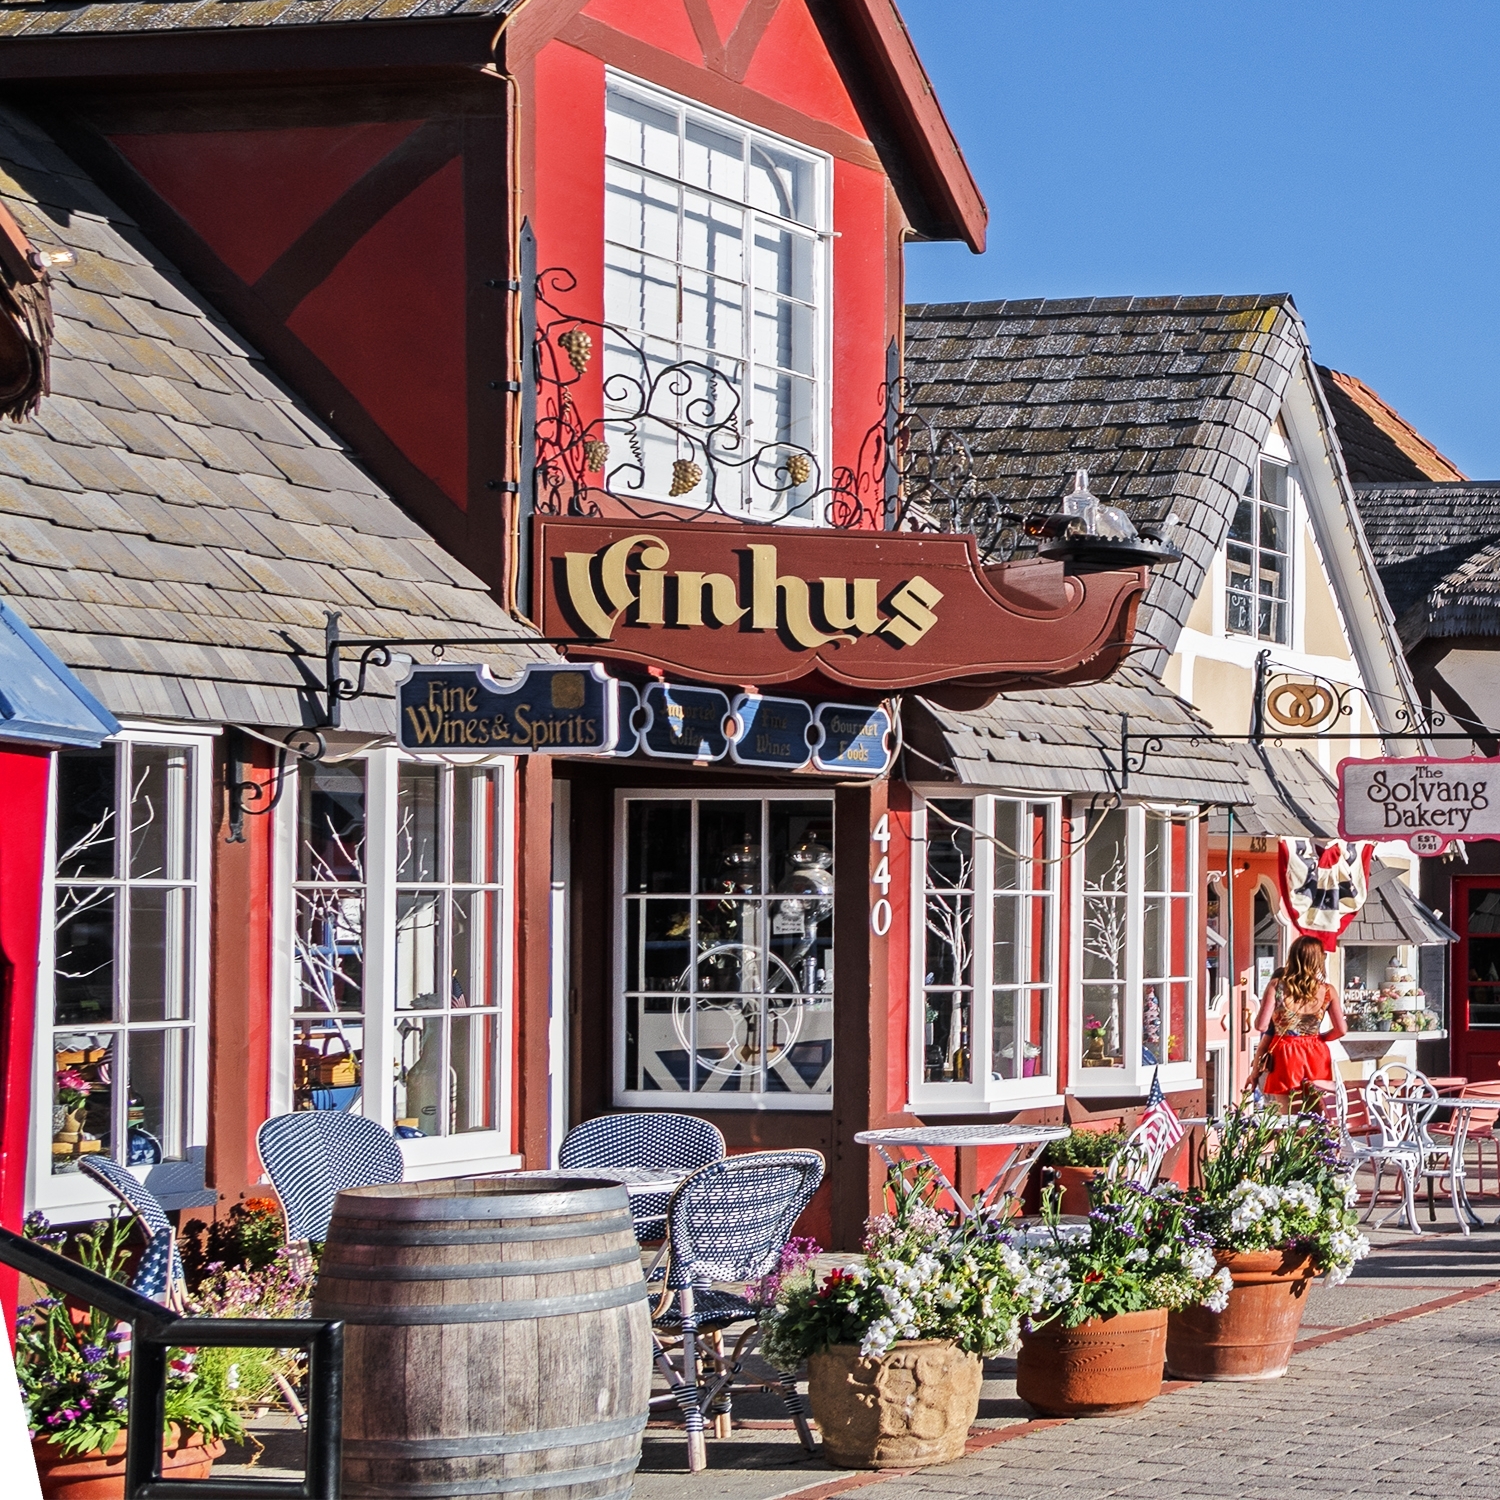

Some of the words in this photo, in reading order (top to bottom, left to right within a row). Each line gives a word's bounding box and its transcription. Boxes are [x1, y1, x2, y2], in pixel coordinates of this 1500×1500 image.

[564, 534, 944, 648] Vinhus
[428, 681, 478, 713] Fine
[659, 697, 717, 720] Imported
[405, 704, 489, 745] Wines
[491, 714, 510, 740] &
[512, 703, 597, 751] Spirits
[761, 707, 788, 730] Fine
[830, 714, 879, 737] Gourmet
[756, 734, 791, 756] Wines
[838, 741, 869, 762] Foods
[1415, 766, 1443, 779] The
[1367, 770, 1489, 810] Solvang
[1383, 802, 1473, 832] Bakery
[1417, 835, 1438, 843] EST
[872, 813, 893, 936] 440
